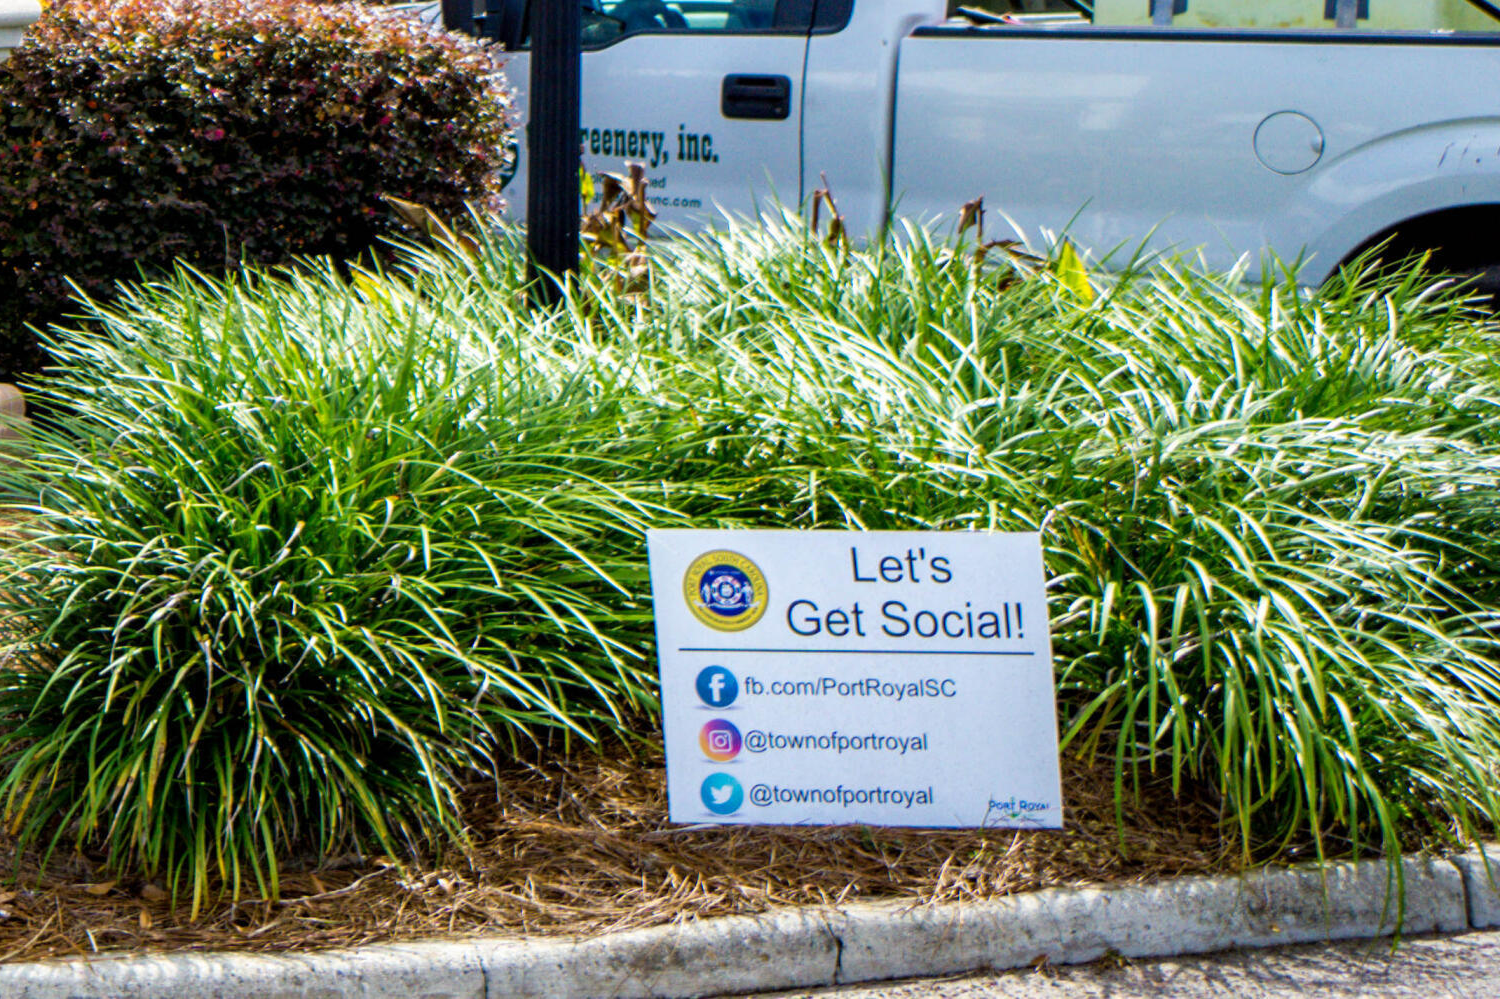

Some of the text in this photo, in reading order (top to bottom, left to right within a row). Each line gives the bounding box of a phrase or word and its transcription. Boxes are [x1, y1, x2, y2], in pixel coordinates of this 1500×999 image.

[579, 122, 719, 169] reenery, inc.
[850, 546, 953, 584] Let's
[786, 600, 867, 638] Get
[880, 600, 1026, 640] Social!
[744, 676, 958, 702] fb.com/PortRoyalSC
[744, 729, 929, 755] @townofportroyal
[749, 783, 934, 809] @townofportroyal
